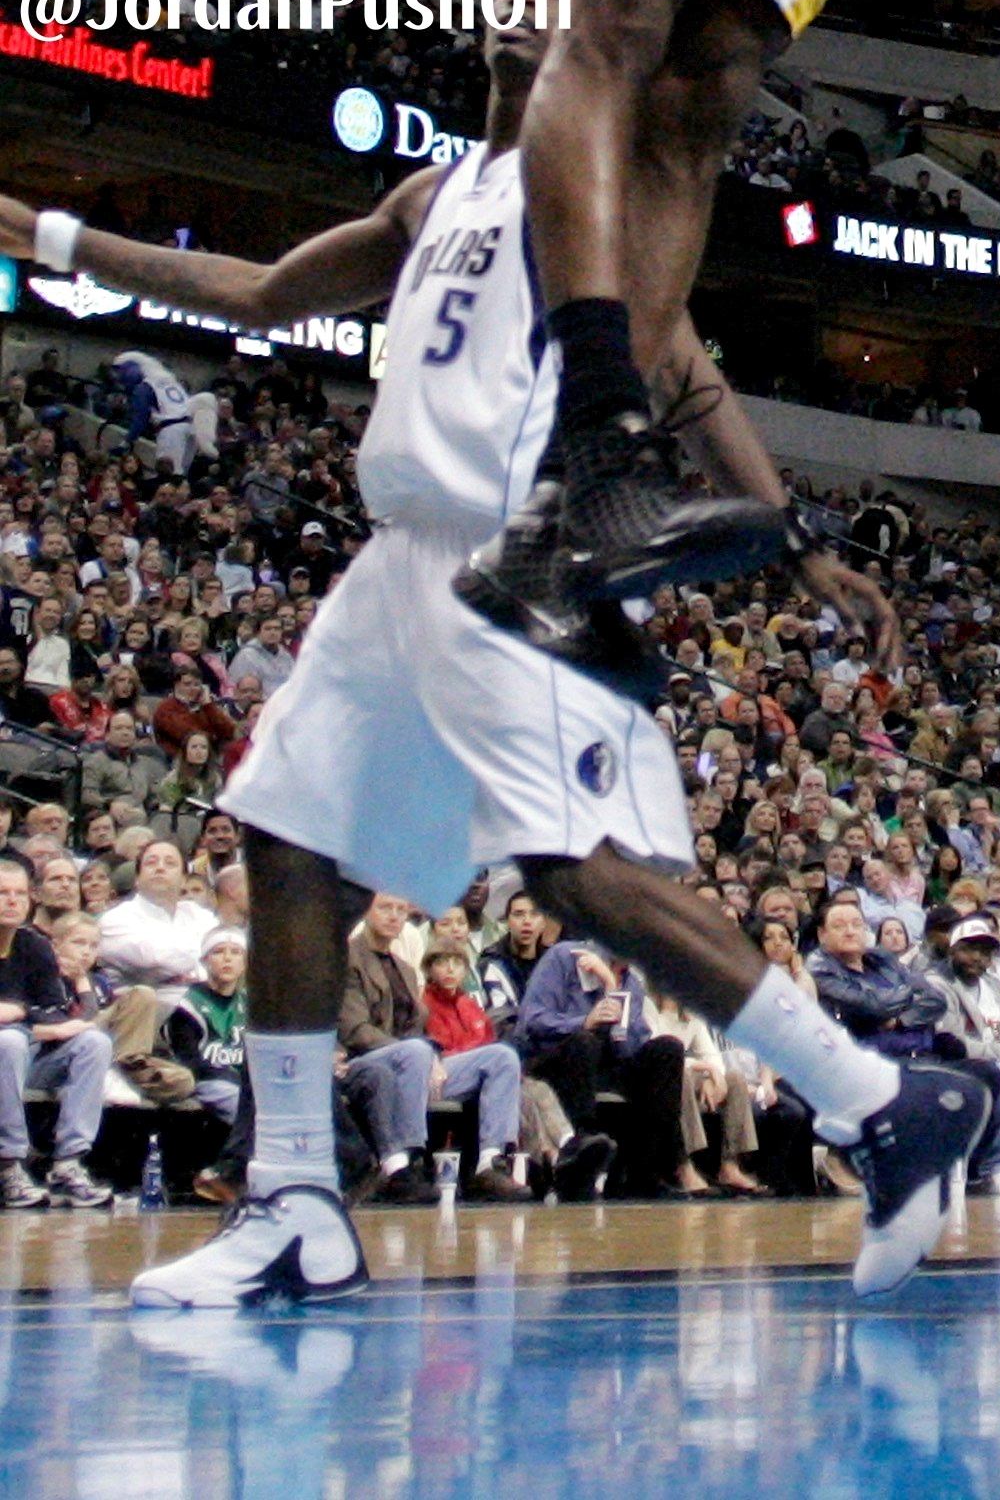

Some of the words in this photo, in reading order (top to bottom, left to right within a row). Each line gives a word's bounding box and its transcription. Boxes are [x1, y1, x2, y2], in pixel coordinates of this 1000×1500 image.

[131, 40, 211, 99] Center!
[834, 215, 899, 261] JACK
[903, 228, 935, 266] IN
[940, 233, 993, 274] THE
[422, 288, 477, 367] 5
